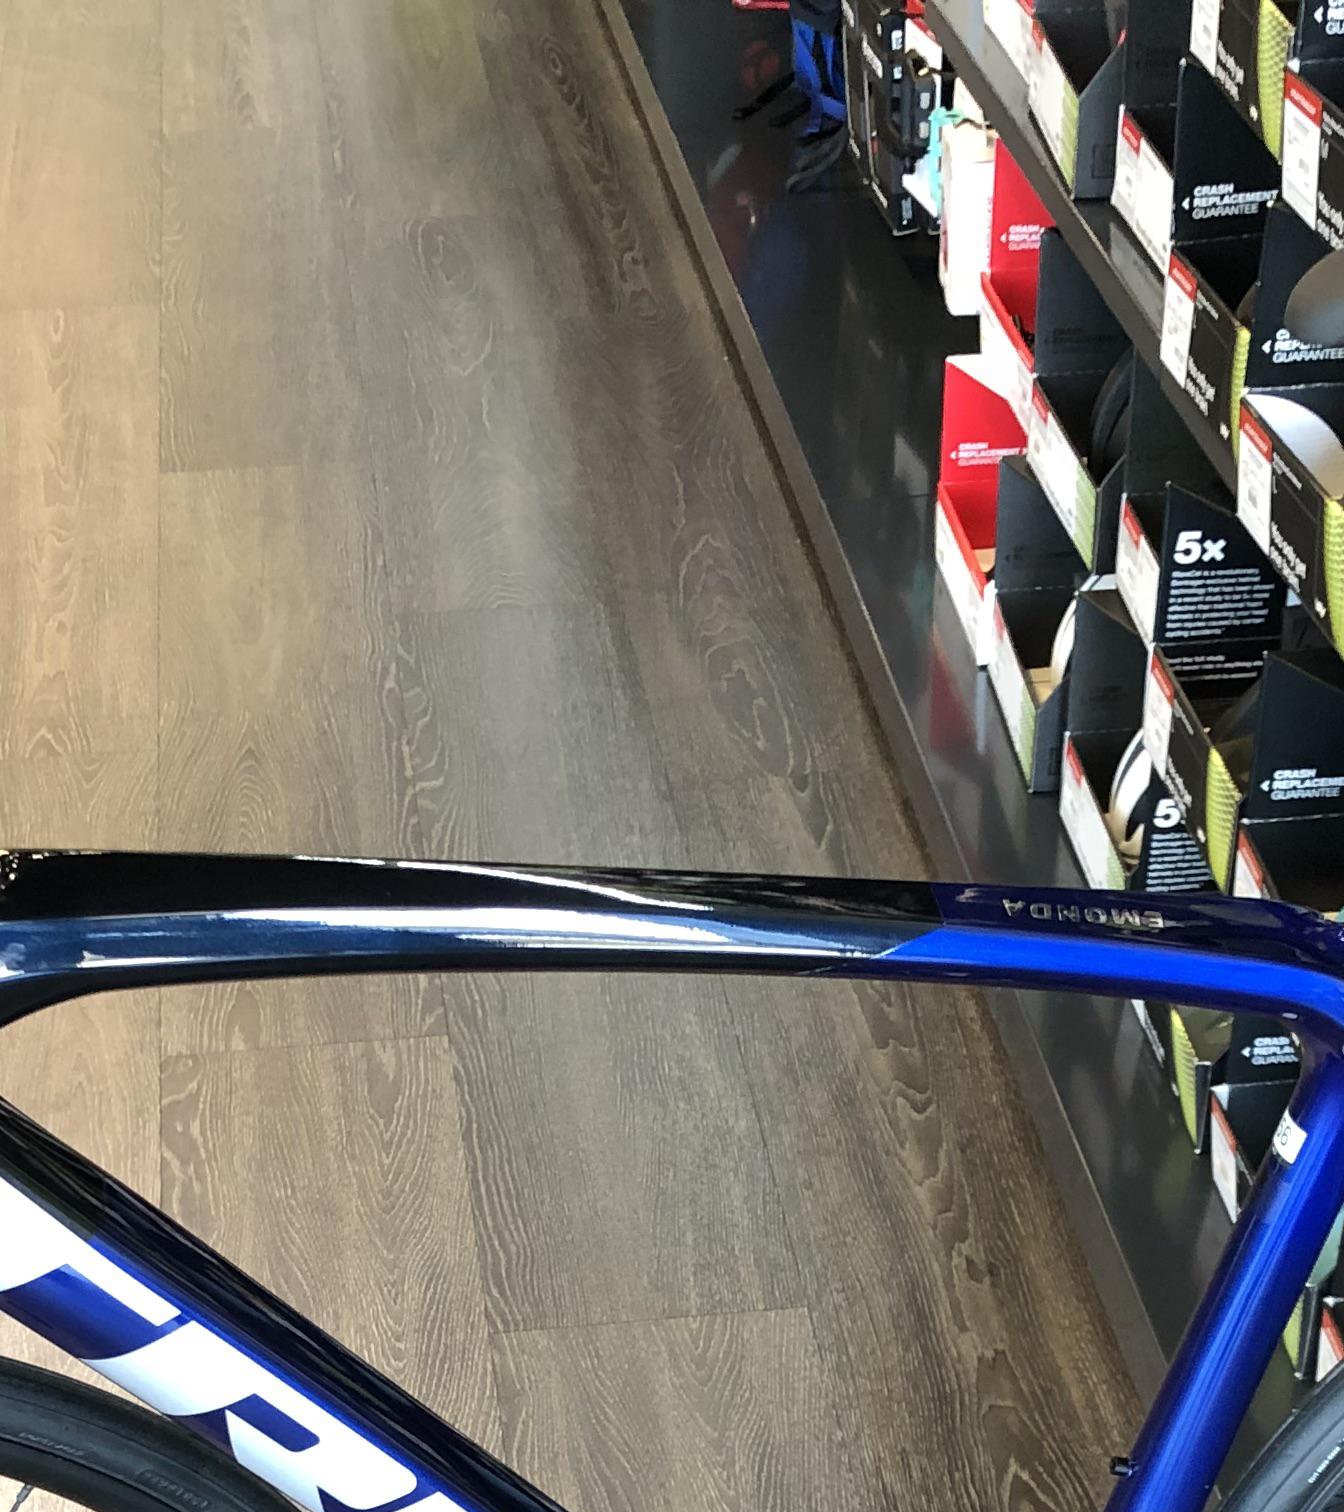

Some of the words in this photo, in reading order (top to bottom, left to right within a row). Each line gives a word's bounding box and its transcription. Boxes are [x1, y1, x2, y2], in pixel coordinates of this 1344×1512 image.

[1193, 182, 1234, 197] CRASH
[1193, 189, 1279, 208] REPLACEMENT
[1192, 202, 1259, 220] GUARANTEE
[1173, 530, 1227, 565] 5x
[1272, 768, 1317, 780] CRASH
[1270, 787, 1341, 801] GUARANTEE
